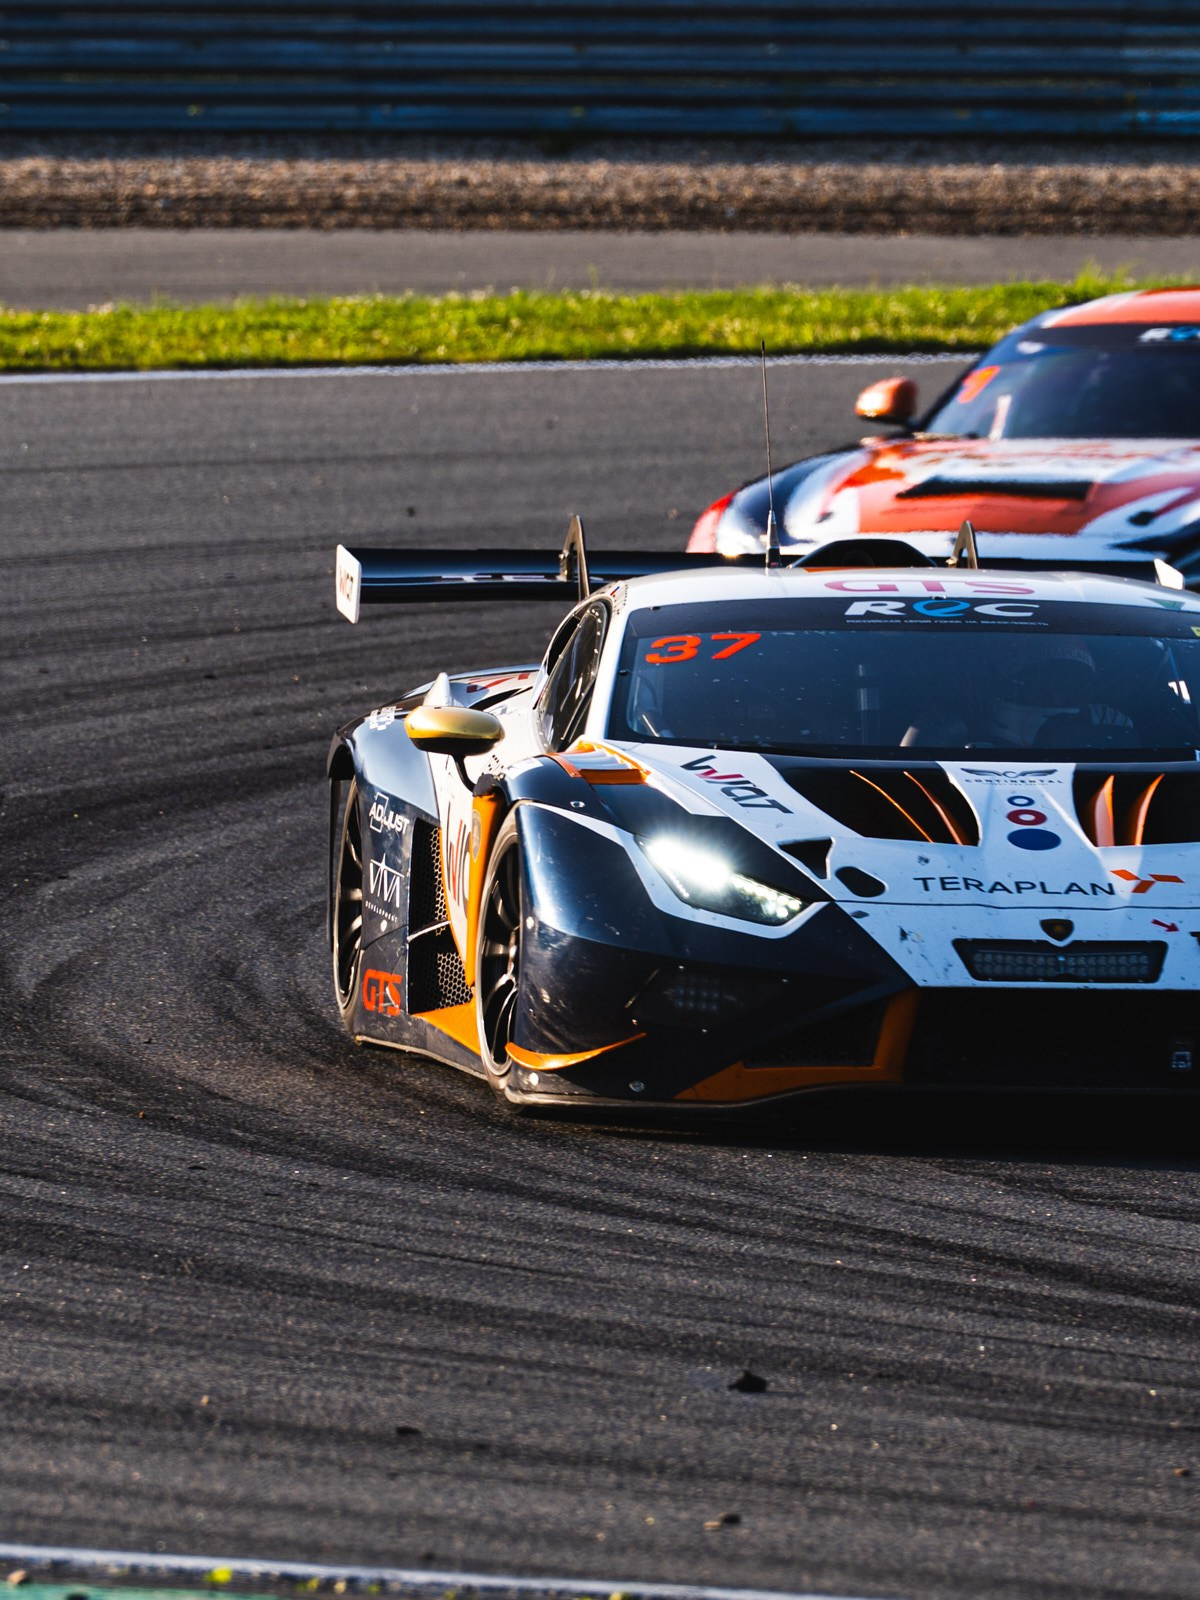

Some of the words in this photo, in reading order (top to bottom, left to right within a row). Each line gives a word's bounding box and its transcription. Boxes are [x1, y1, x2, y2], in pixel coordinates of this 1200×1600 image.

[824, 579, 1035, 595] GTS
[645, 632, 762, 665] 37
[368, 802, 411, 835] ADJUST
[913, 876, 1116, 896] TERAPLAN
[365, 900, 398, 922] DEVELOPMENT
[362, 968, 403, 1017] GTS
